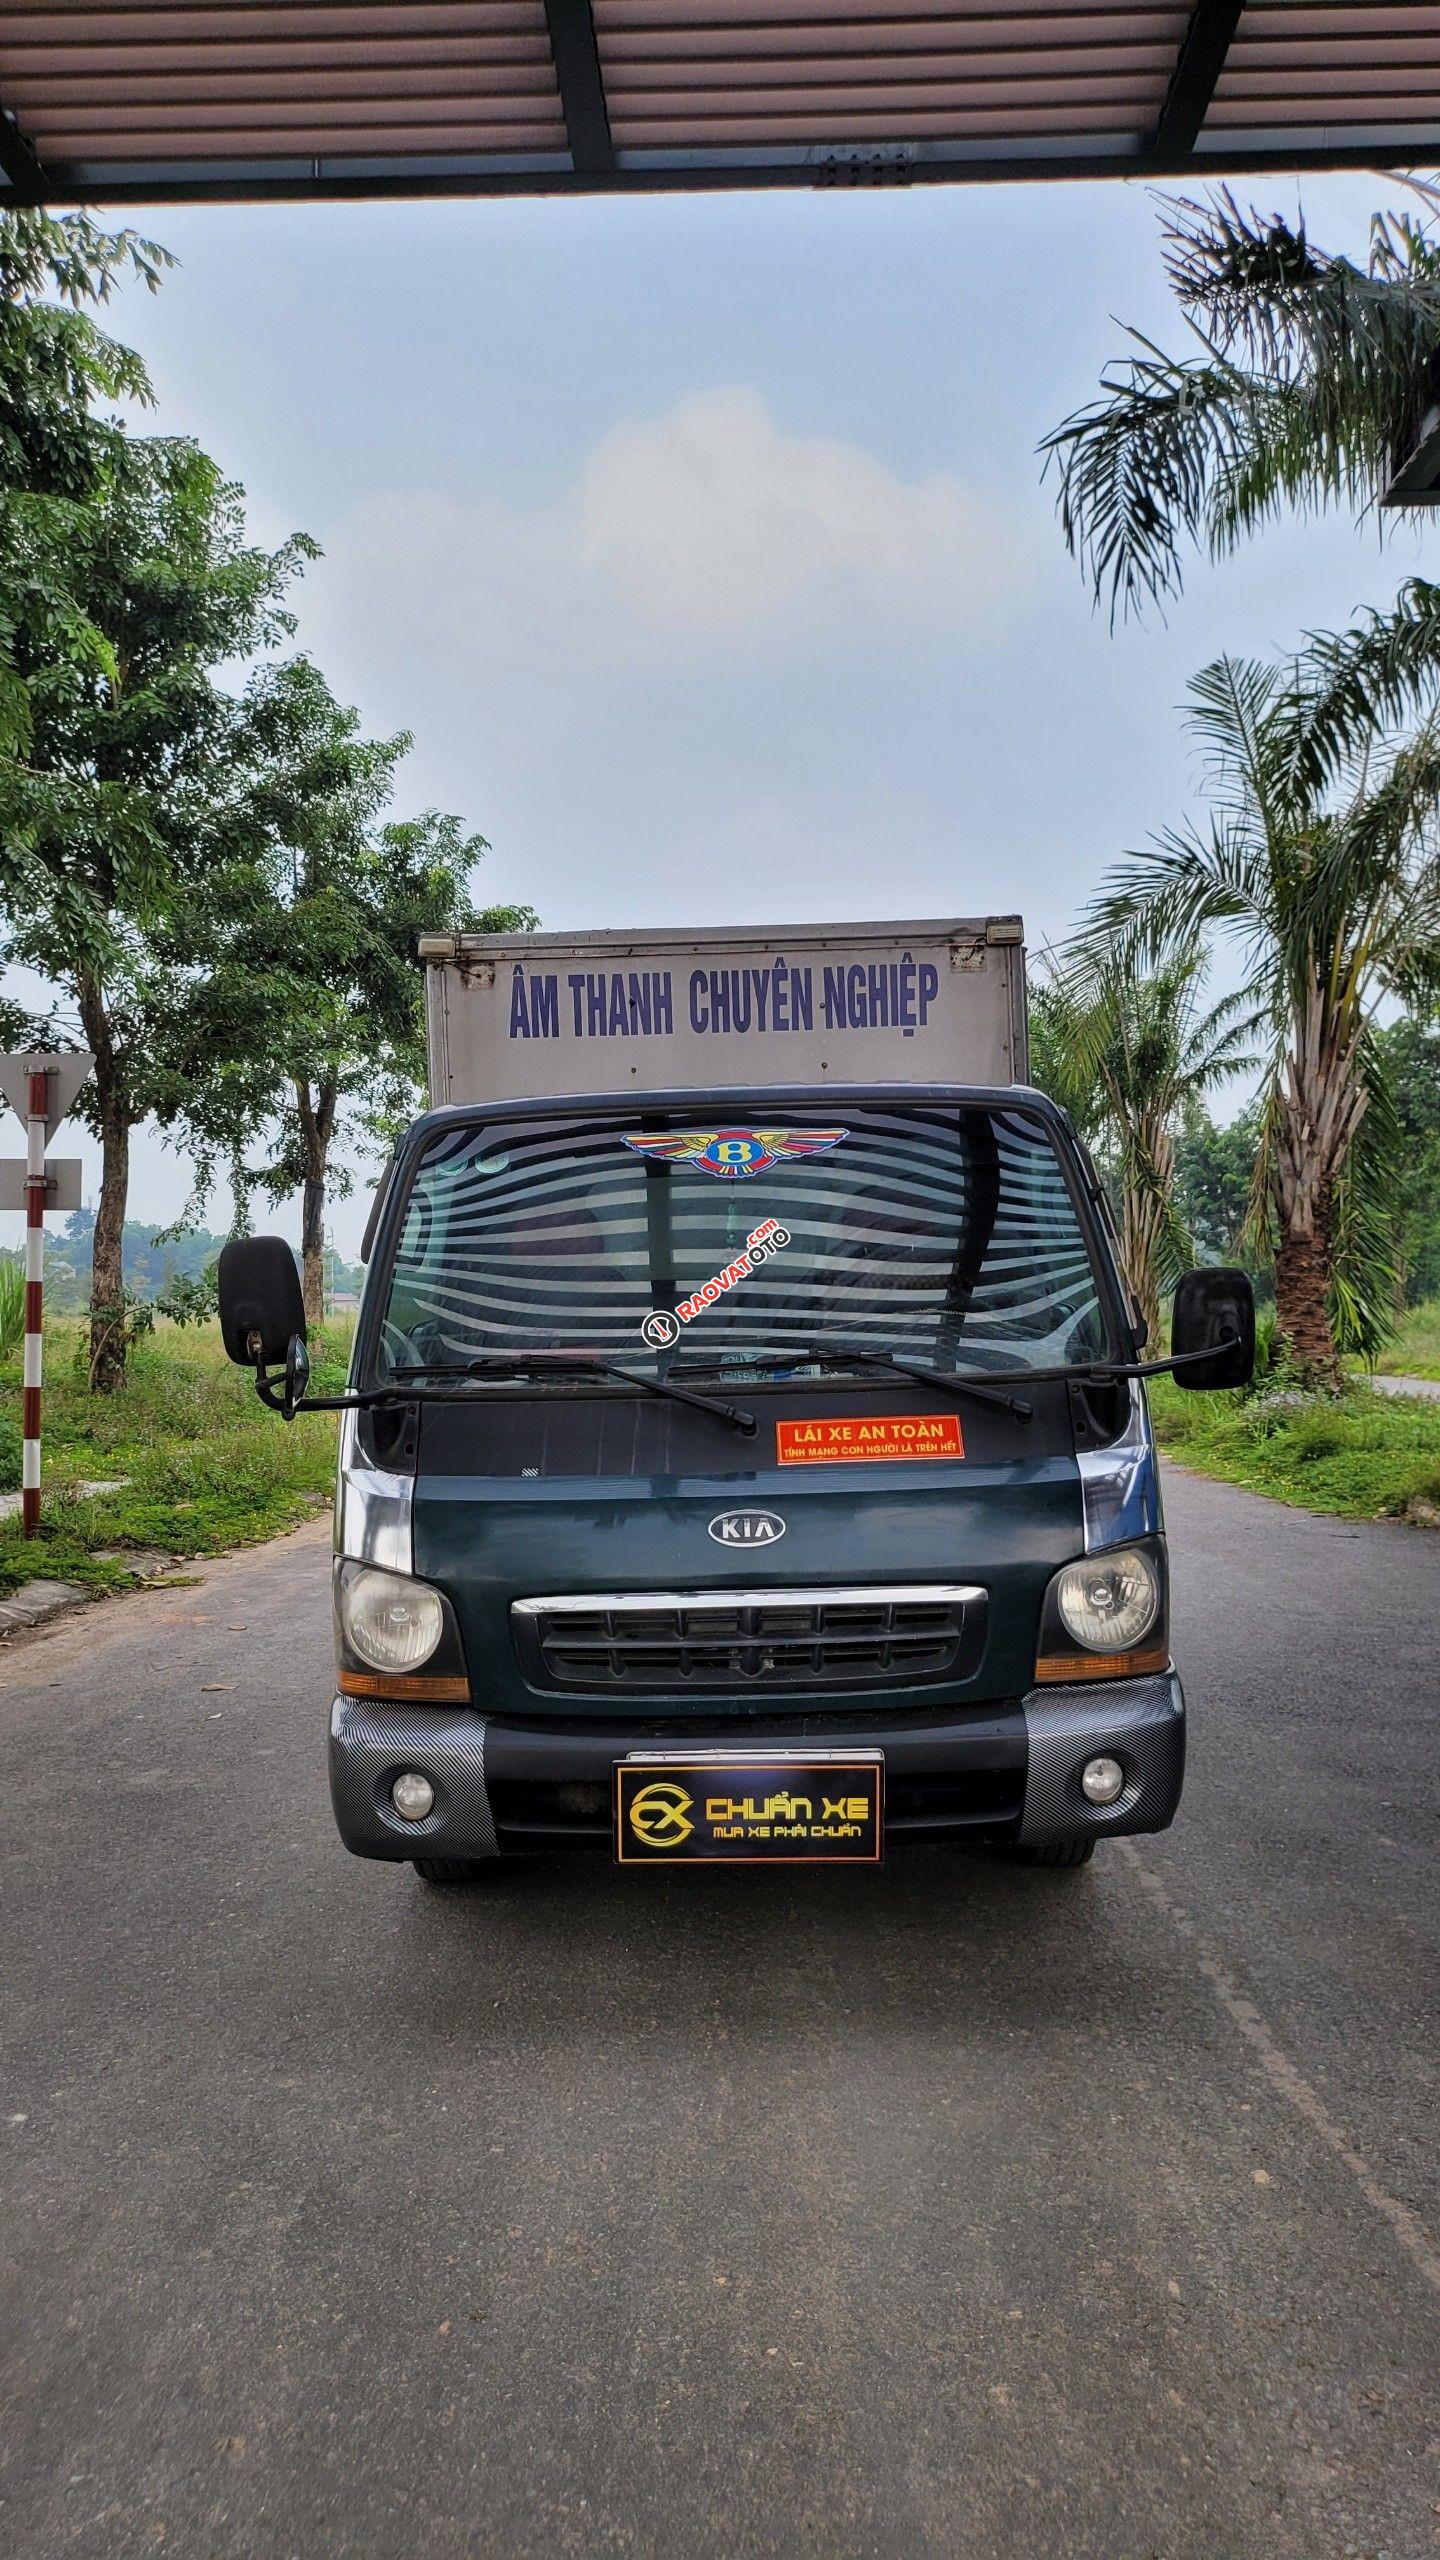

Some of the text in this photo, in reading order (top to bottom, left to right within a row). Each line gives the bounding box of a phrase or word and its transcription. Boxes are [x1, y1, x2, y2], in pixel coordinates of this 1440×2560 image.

[510, 952, 938, 1039] ÂM THANH CHUYÊN NGHIỆP
[718, 1141, 752, 1164] B
[794, 1420, 944, 1442] LÁI XE AN TOÀN
[841, 1445, 864, 1454] CON
[901, 1443, 913, 1453] LÀ
[915, 1442, 937, 1452] TRÊN
[940, 1440, 957, 1451] HẾT
[721, 1517, 775, 1539] KIA
[821, 1797, 869, 1819] XE
[713, 1826, 744, 1838] MUA
[748, 1825, 771, 1837] XE
